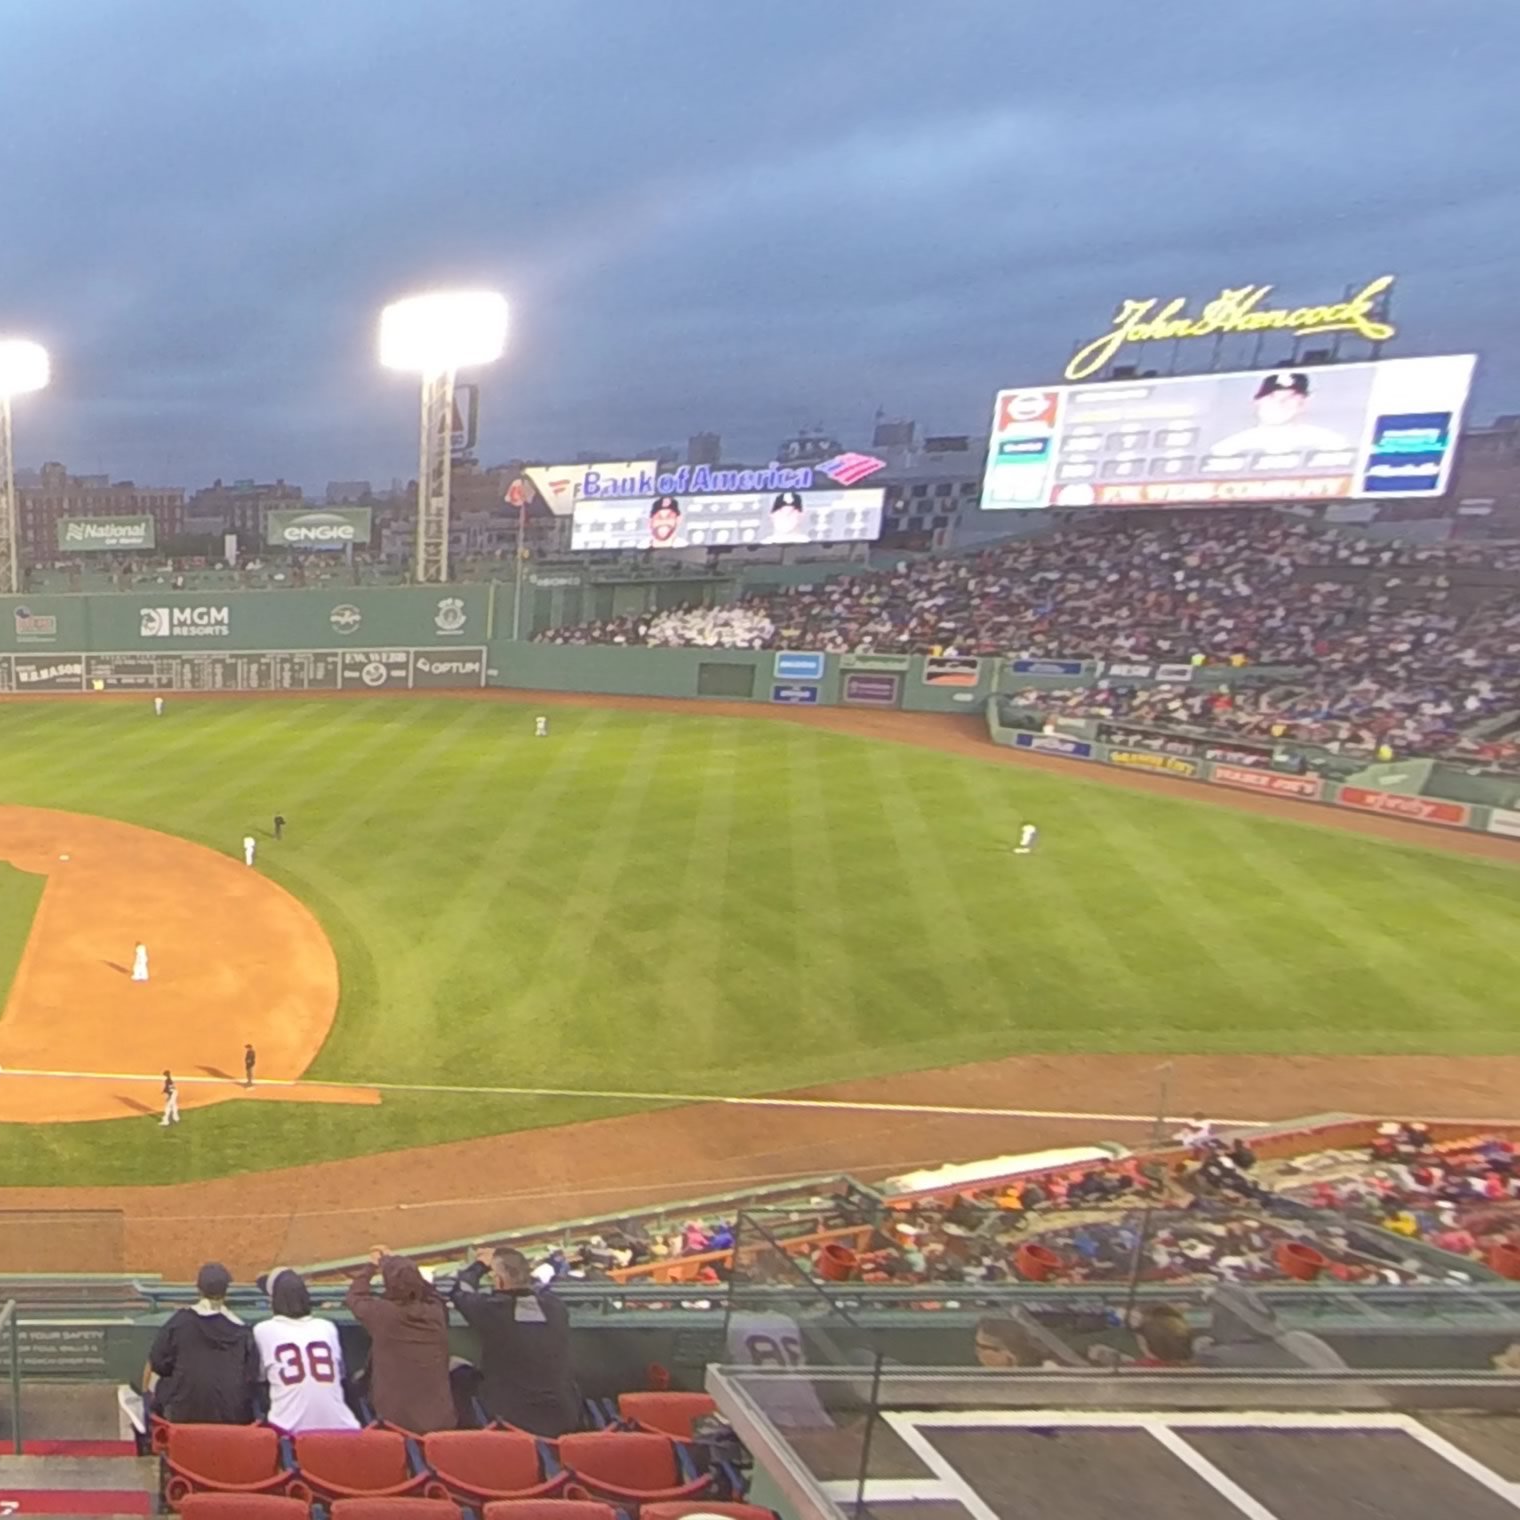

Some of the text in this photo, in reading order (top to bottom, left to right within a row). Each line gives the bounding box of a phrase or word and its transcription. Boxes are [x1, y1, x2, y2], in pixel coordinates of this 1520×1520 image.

[1065, 275, 1395, 380] John Hancock
[583, 470, 655, 497] Bank
[657, 465, 690, 494] of
[689, 461, 814, 492] America
[84, 523, 145, 538] National
[173, 607, 229, 625] MGM
[173, 625, 229, 636] RESORTS
[431, 662, 480, 674] OPTUM
[30, 1331, 61, 1339] YOUR
[62, 1331, 105, 1339] SAFETY
[274, 1341, 335, 1386] 38
